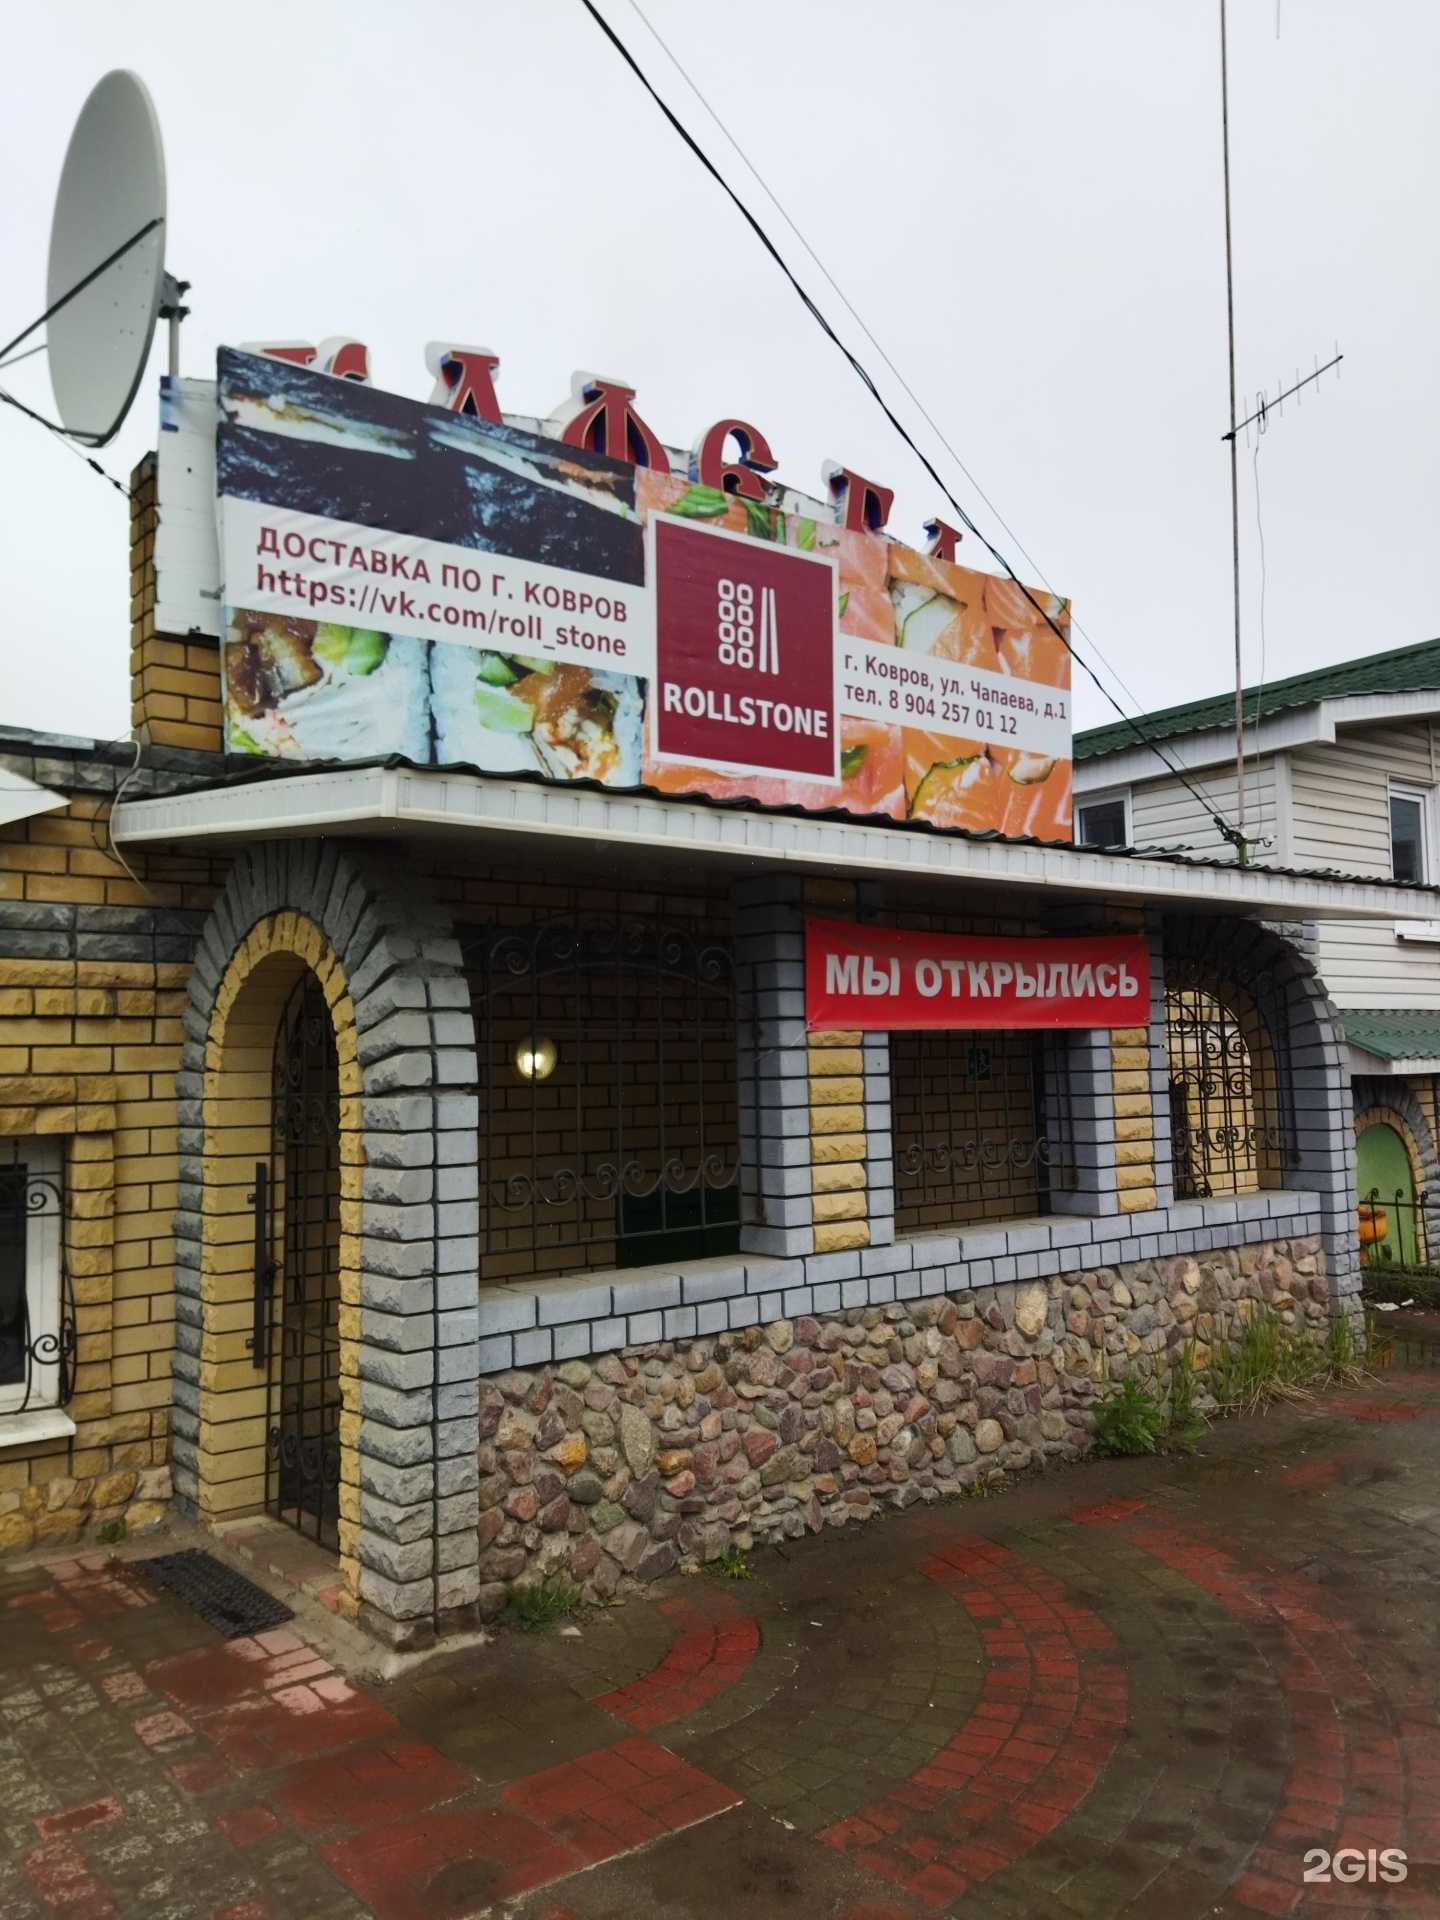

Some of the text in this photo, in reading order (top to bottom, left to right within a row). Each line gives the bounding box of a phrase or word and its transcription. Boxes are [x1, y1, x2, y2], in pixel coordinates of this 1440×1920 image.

[257, 526, 627, 623] ДОСТАВКА ПО Г. КОВРОВ
[257, 564, 627, 656] https://vk.com/roll_stone
[663, 682, 828, 738] ROLLSTONE
[844, 654, 1067, 720] г. Ковров, ул. Чапаева, д.1
[844, 684, 1018, 735] тел. 8 904 257 01 12
[825, 953, 1139, 998] МЫ ОТКРЫЛИСЬ
